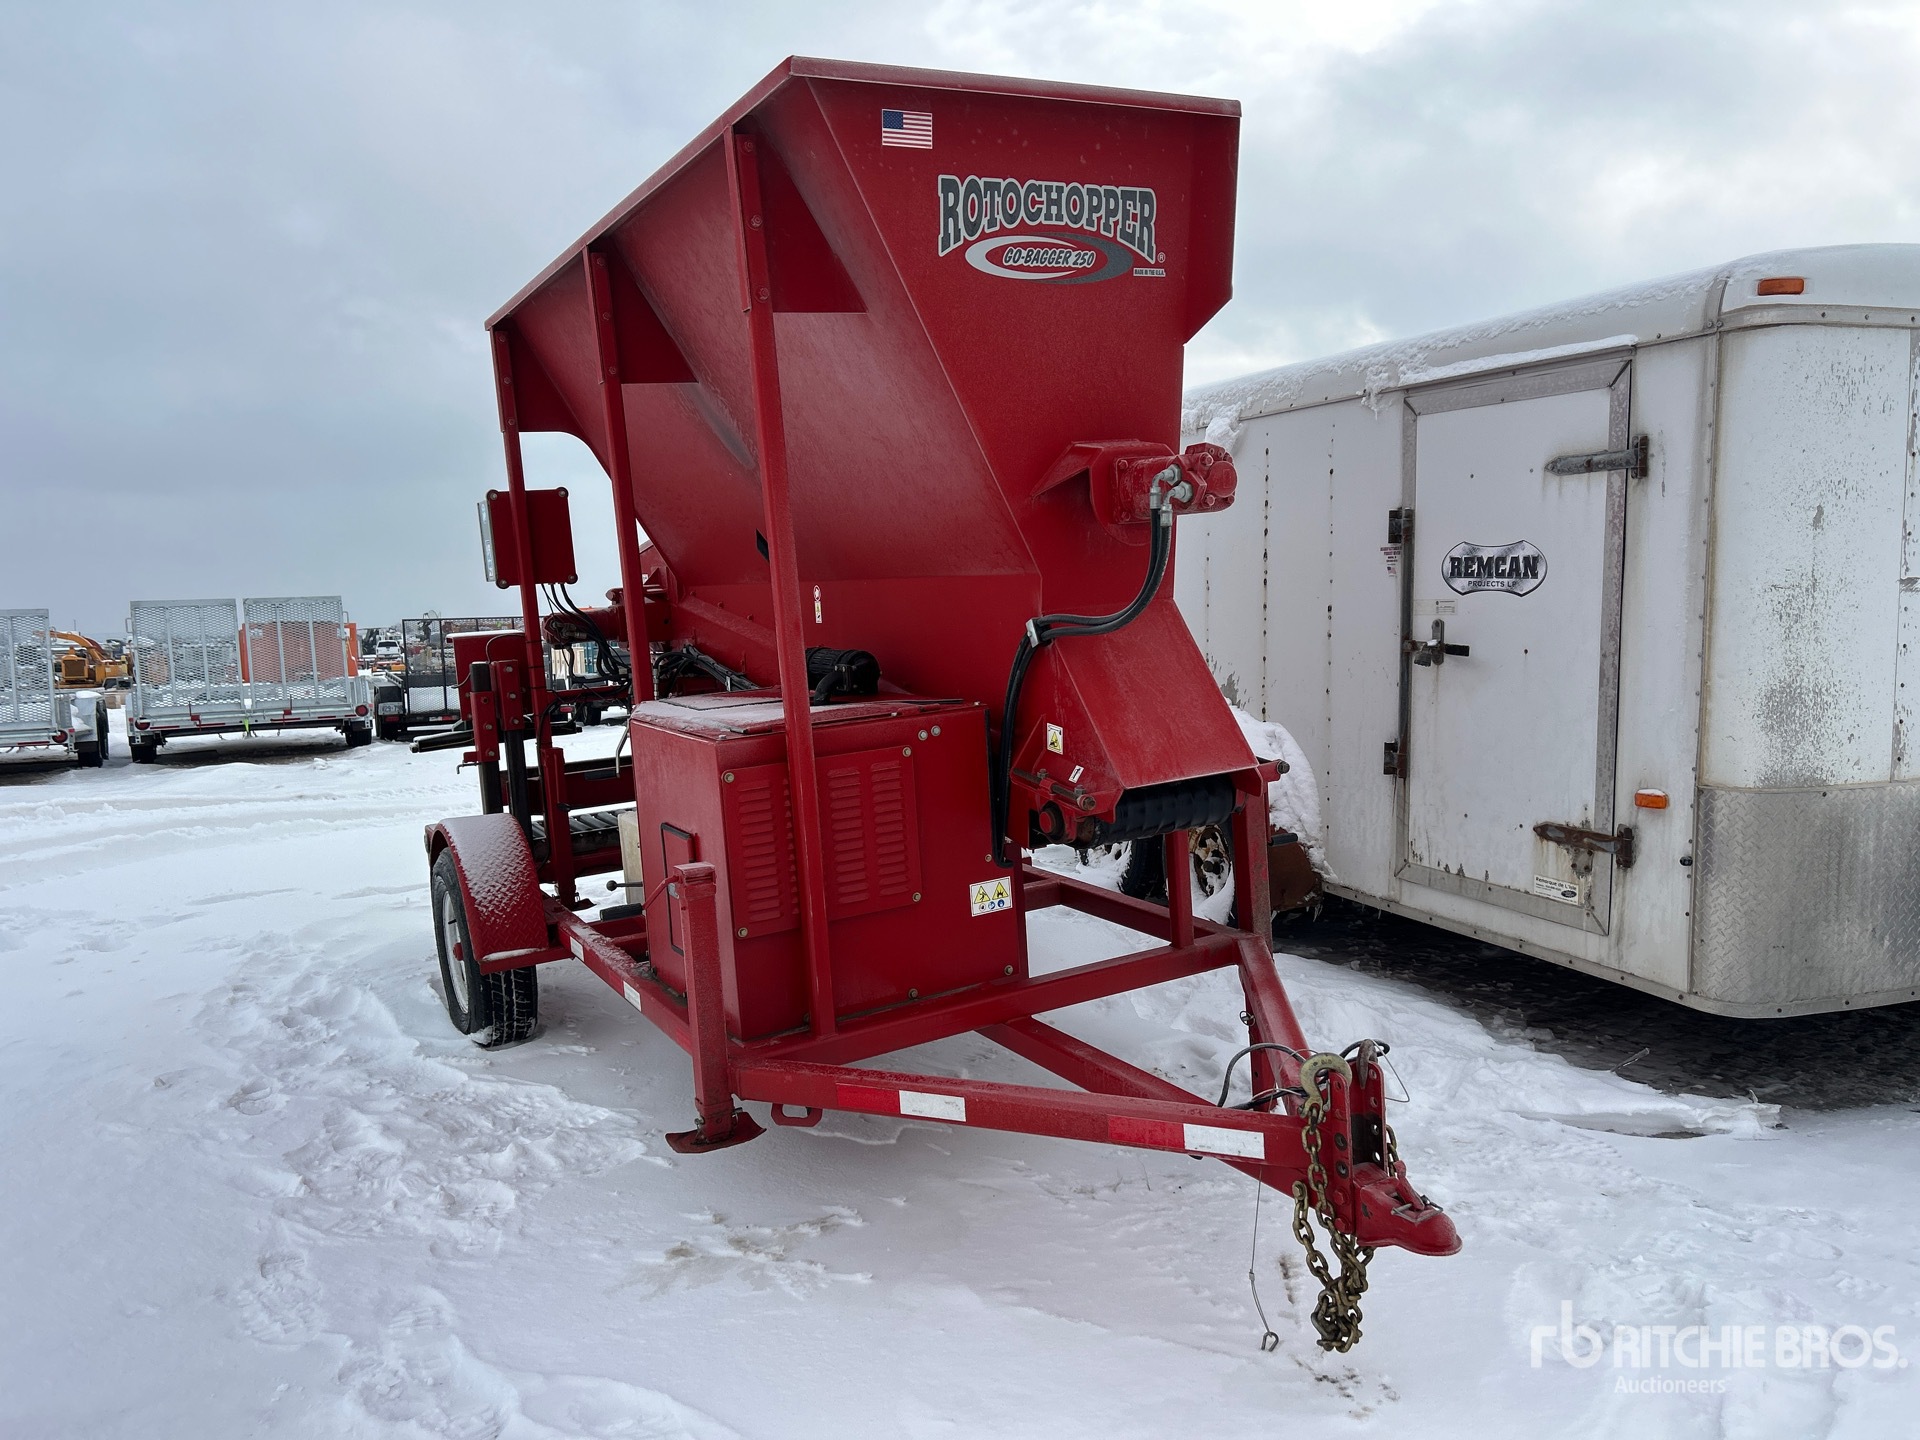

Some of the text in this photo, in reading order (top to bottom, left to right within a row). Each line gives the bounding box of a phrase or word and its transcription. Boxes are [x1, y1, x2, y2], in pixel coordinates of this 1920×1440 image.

[938, 174, 1156, 264] ROTOCHOPPER
[1003, 247, 1096, 267] GO-BAGGER 250
[1449, 555, 1540, 580] REMCAN
[1467, 580, 1517, 588] PROJECTS LP
